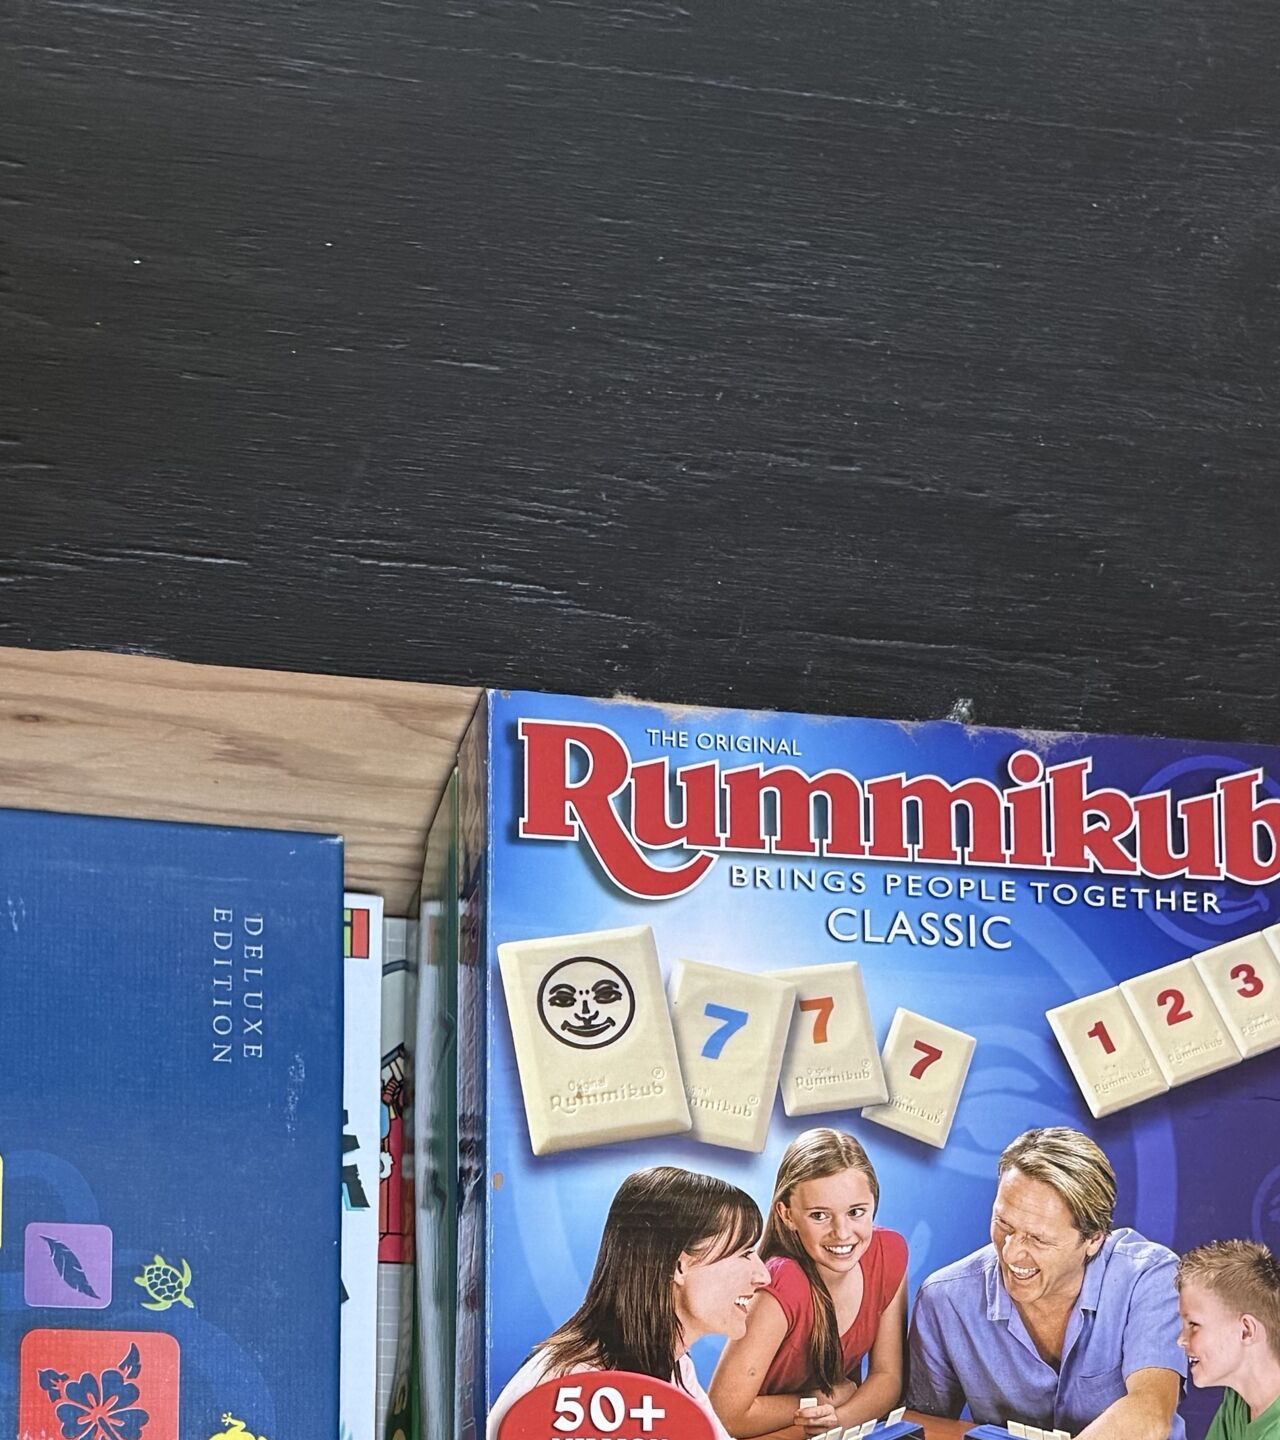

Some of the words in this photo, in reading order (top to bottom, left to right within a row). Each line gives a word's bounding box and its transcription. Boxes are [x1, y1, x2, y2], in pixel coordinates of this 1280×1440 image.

[646, 728, 691, 750] THE
[696, 733, 803, 758] ORIGINAL
[729, 865, 868, 897] BRINGS
[883, 872, 1018, 904] PEOPLE
[1030, 881, 1223, 915] TOGETHER
[826, 908, 1014, 950] CLASSIC
[212, 907, 234, 1066] EDITION
[243, 915, 265, 1062] DELUXE
[1229, 963, 1265, 999] 3
[798, 996, 836, 1046] 7
[1156, 988, 1194, 1027] 2
[699, 1002, 750, 1061] 7
[1086, 1020, 1117, 1056] 1
[908, 1039, 944, 1081] 7
[549, 1081, 666, 1114] Rummikub
[552, 1386, 666, 1433] 50+
